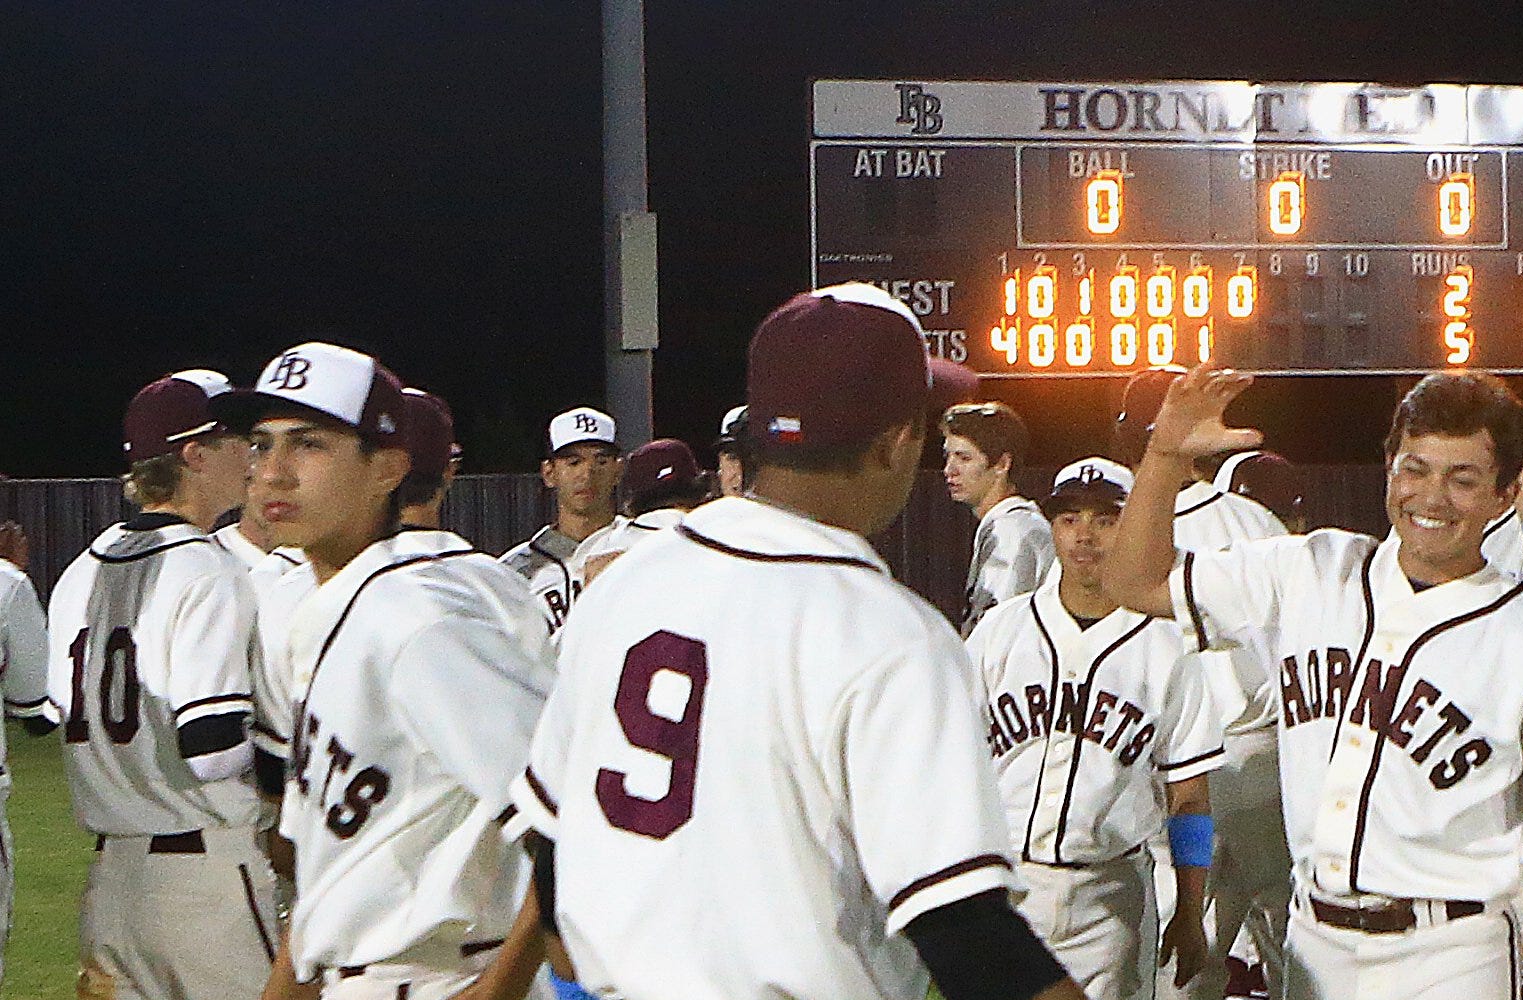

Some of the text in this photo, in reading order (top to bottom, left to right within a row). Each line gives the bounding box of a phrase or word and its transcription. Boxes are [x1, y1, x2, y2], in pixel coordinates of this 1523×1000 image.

[1040, 88, 1284, 133] HORNT
[853, 150, 946, 178] AT BAT
[1068, 151, 1135, 179] BALL
[1238, 152, 1333, 181] STRIKE
[1426, 154, 1479, 182] OUT
[1086, 178, 1121, 234] 0
[1269, 180, 1301, 235] 0
[1438, 180, 1471, 236] 0
[998, 253, 1009, 276] 1
[1072, 253, 1088, 277] 3
[1270, 254, 1283, 275] 8
[1306, 254, 1320, 275] 9
[1343, 254, 1369, 276] 10
[882, 281, 955, 316] EST
[1027, 275, 1055, 318] 0
[1109, 275, 1137, 318] 0
[1146, 275, 1174, 318] 0
[1183, 275, 1211, 318] 0
[1227, 275, 1254, 318] 0
[1443, 275, 1469, 316] 2
[991, 325, 1018, 364] 4
[1028, 323, 1055, 367] 0
[1065, 323, 1093, 367] 0
[1110, 323, 1138, 367] 0
[1147, 323, 1175, 367] 0
[1443, 321, 1470, 364] 5
[65, 625, 142, 745] 10
[594, 629, 710, 840] 9
[987, 682, 1156, 766] HORNETS
[1279, 646, 1493, 790] HORNETS
